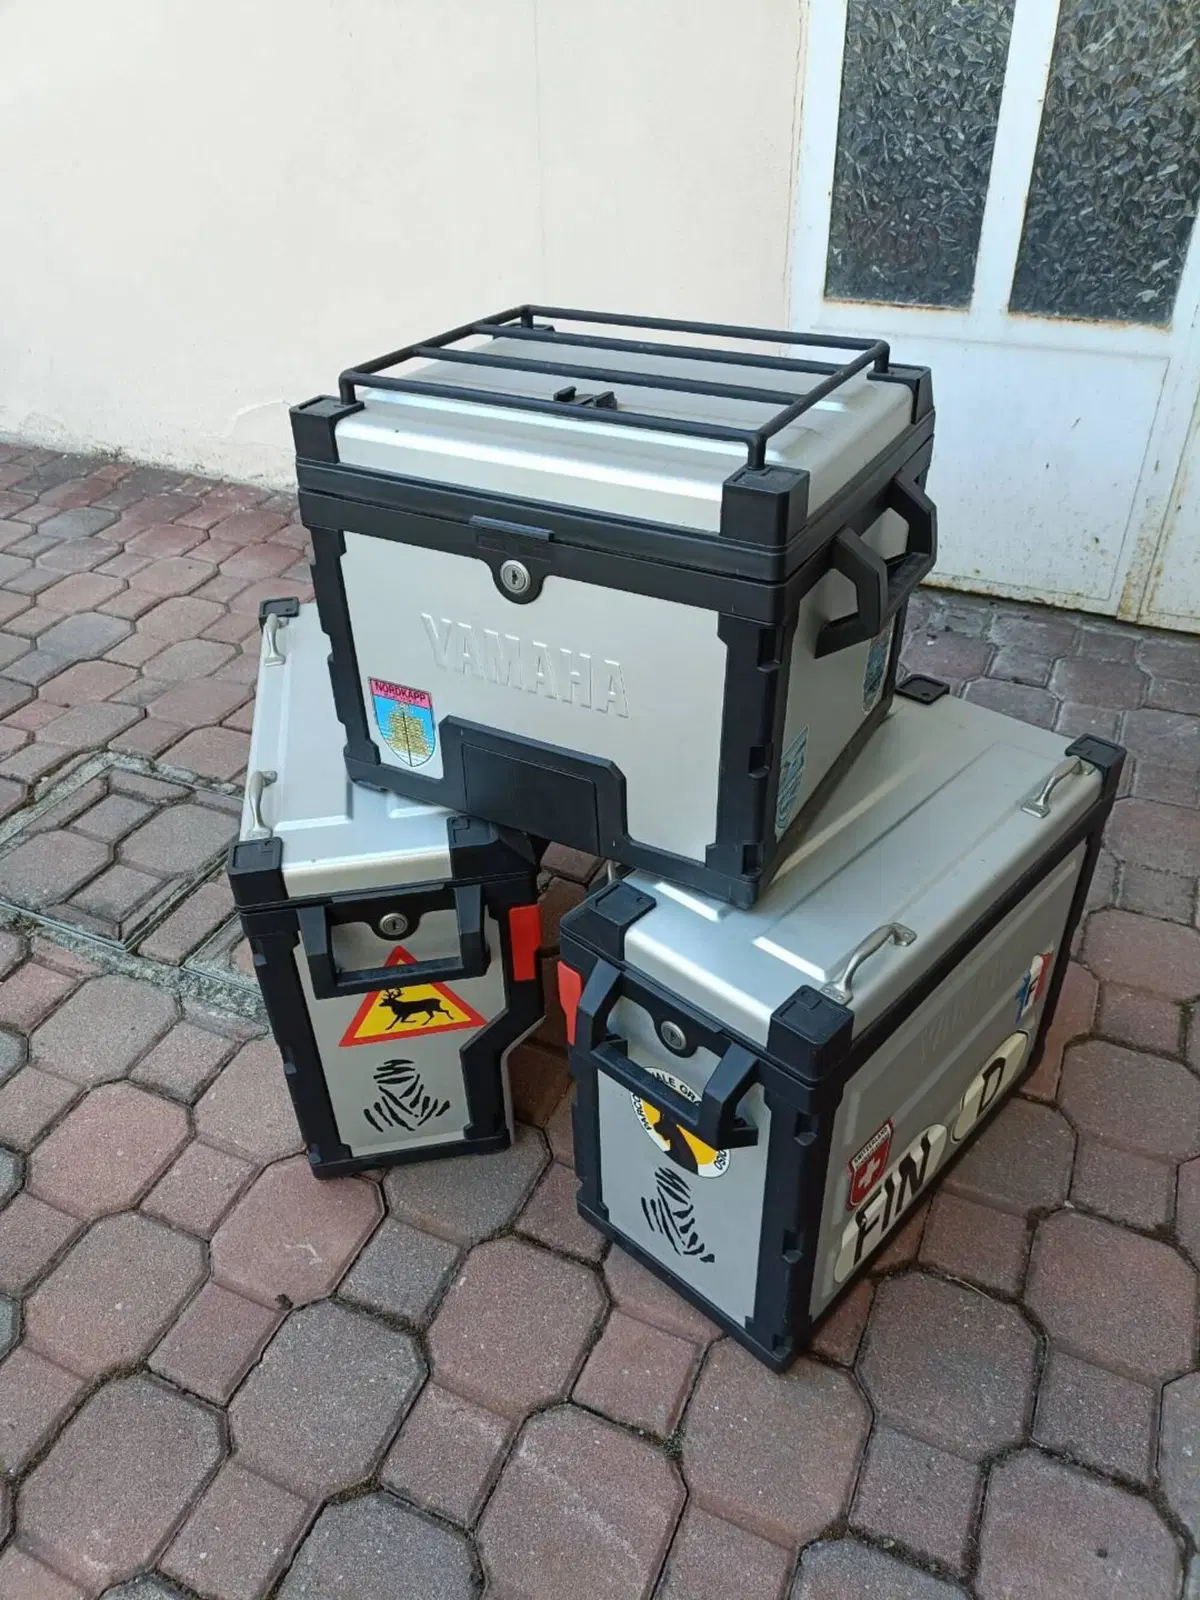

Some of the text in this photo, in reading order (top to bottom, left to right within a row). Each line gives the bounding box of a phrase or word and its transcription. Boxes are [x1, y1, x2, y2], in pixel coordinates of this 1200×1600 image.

[375, 681, 426, 701] NORDKAPP
[420, 612, 629, 719] YAMAHA
[853, 1126, 889, 1163] SWITZERLAND
[853, 1131, 932, 1266] FIN
